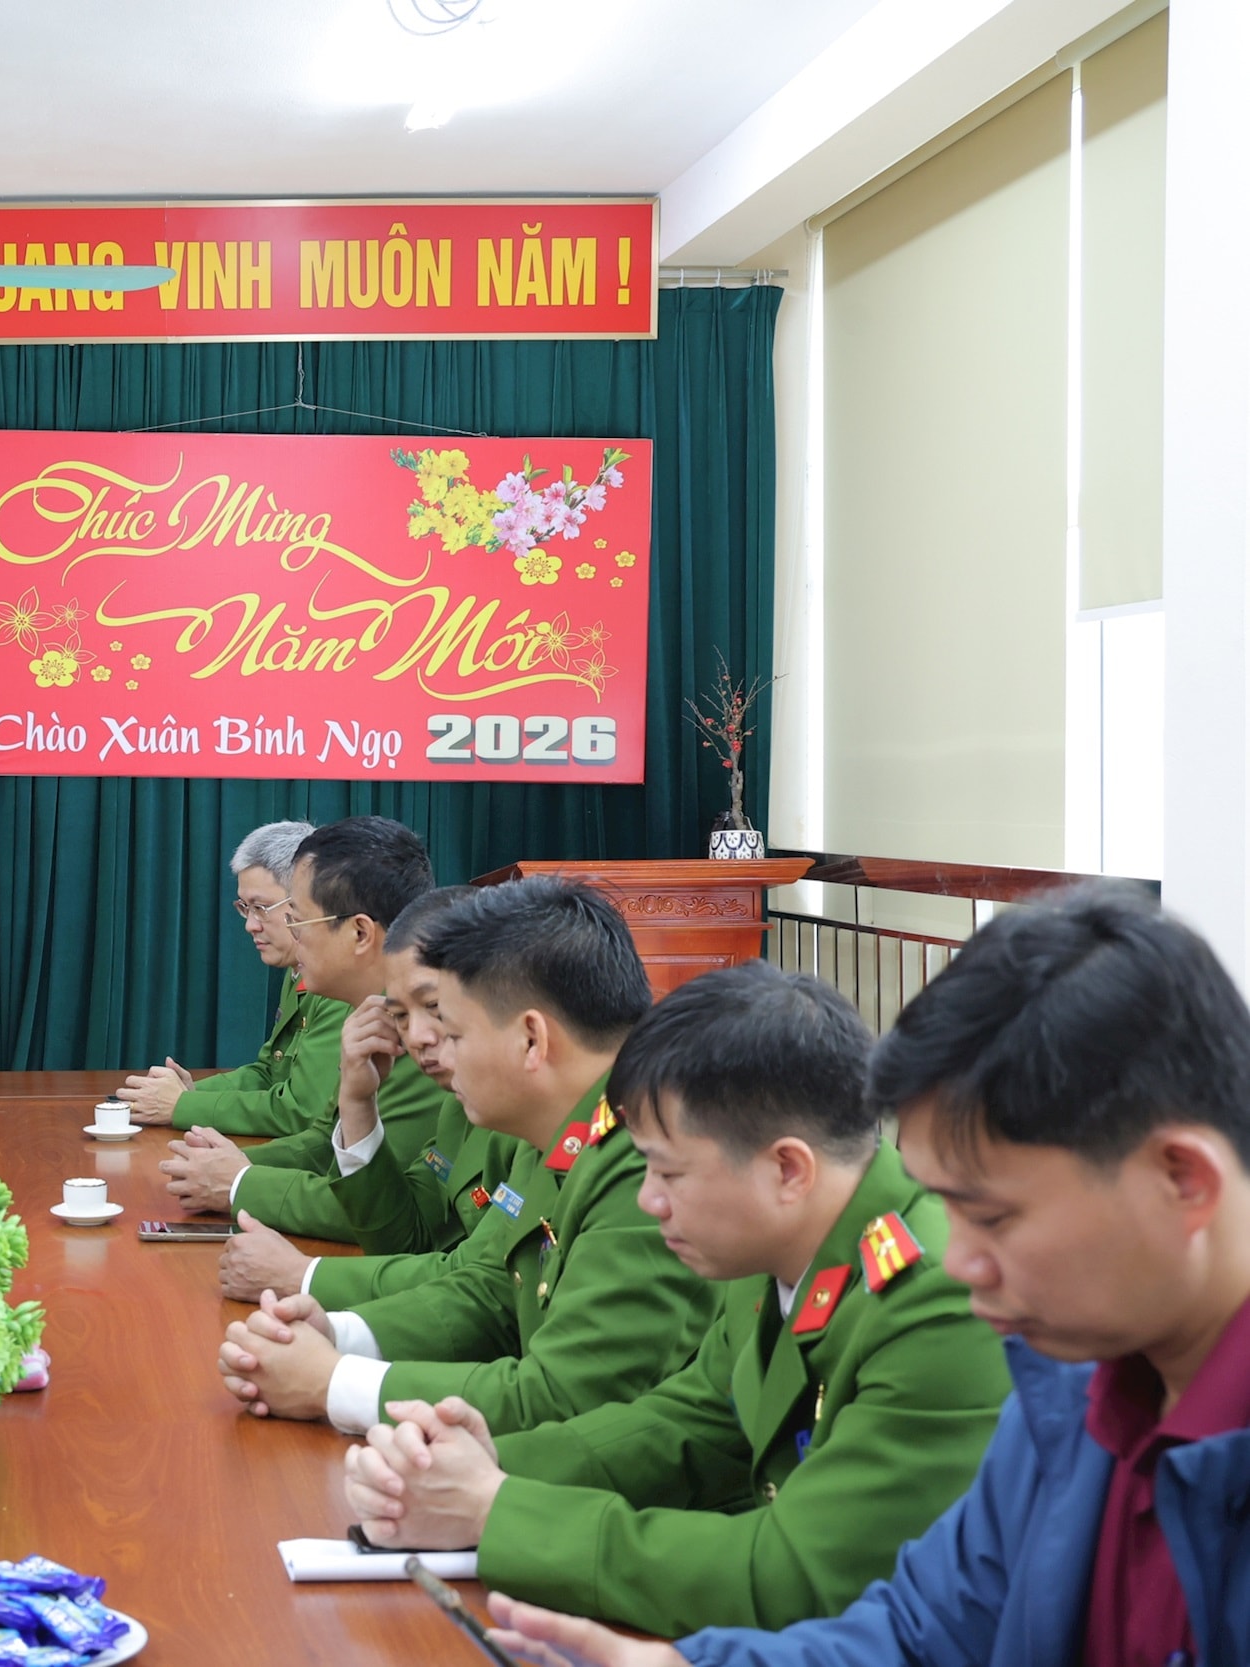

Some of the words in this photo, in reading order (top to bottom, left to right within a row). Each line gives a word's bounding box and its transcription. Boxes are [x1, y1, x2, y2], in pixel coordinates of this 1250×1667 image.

[154, 241, 272, 310] VINH
[299, 222, 452, 309] MUÔN
[477, 222, 598, 308] NĂM
[617, 237, 632, 305] !
[96, 580, 356, 681] Năm
[308, 570, 601, 703] Mới
[99, 714, 201, 762] Xuân
[213, 714, 306, 757] Bính
[316, 719, 403, 770] Ngọ
[425, 714, 618, 765] 2026
